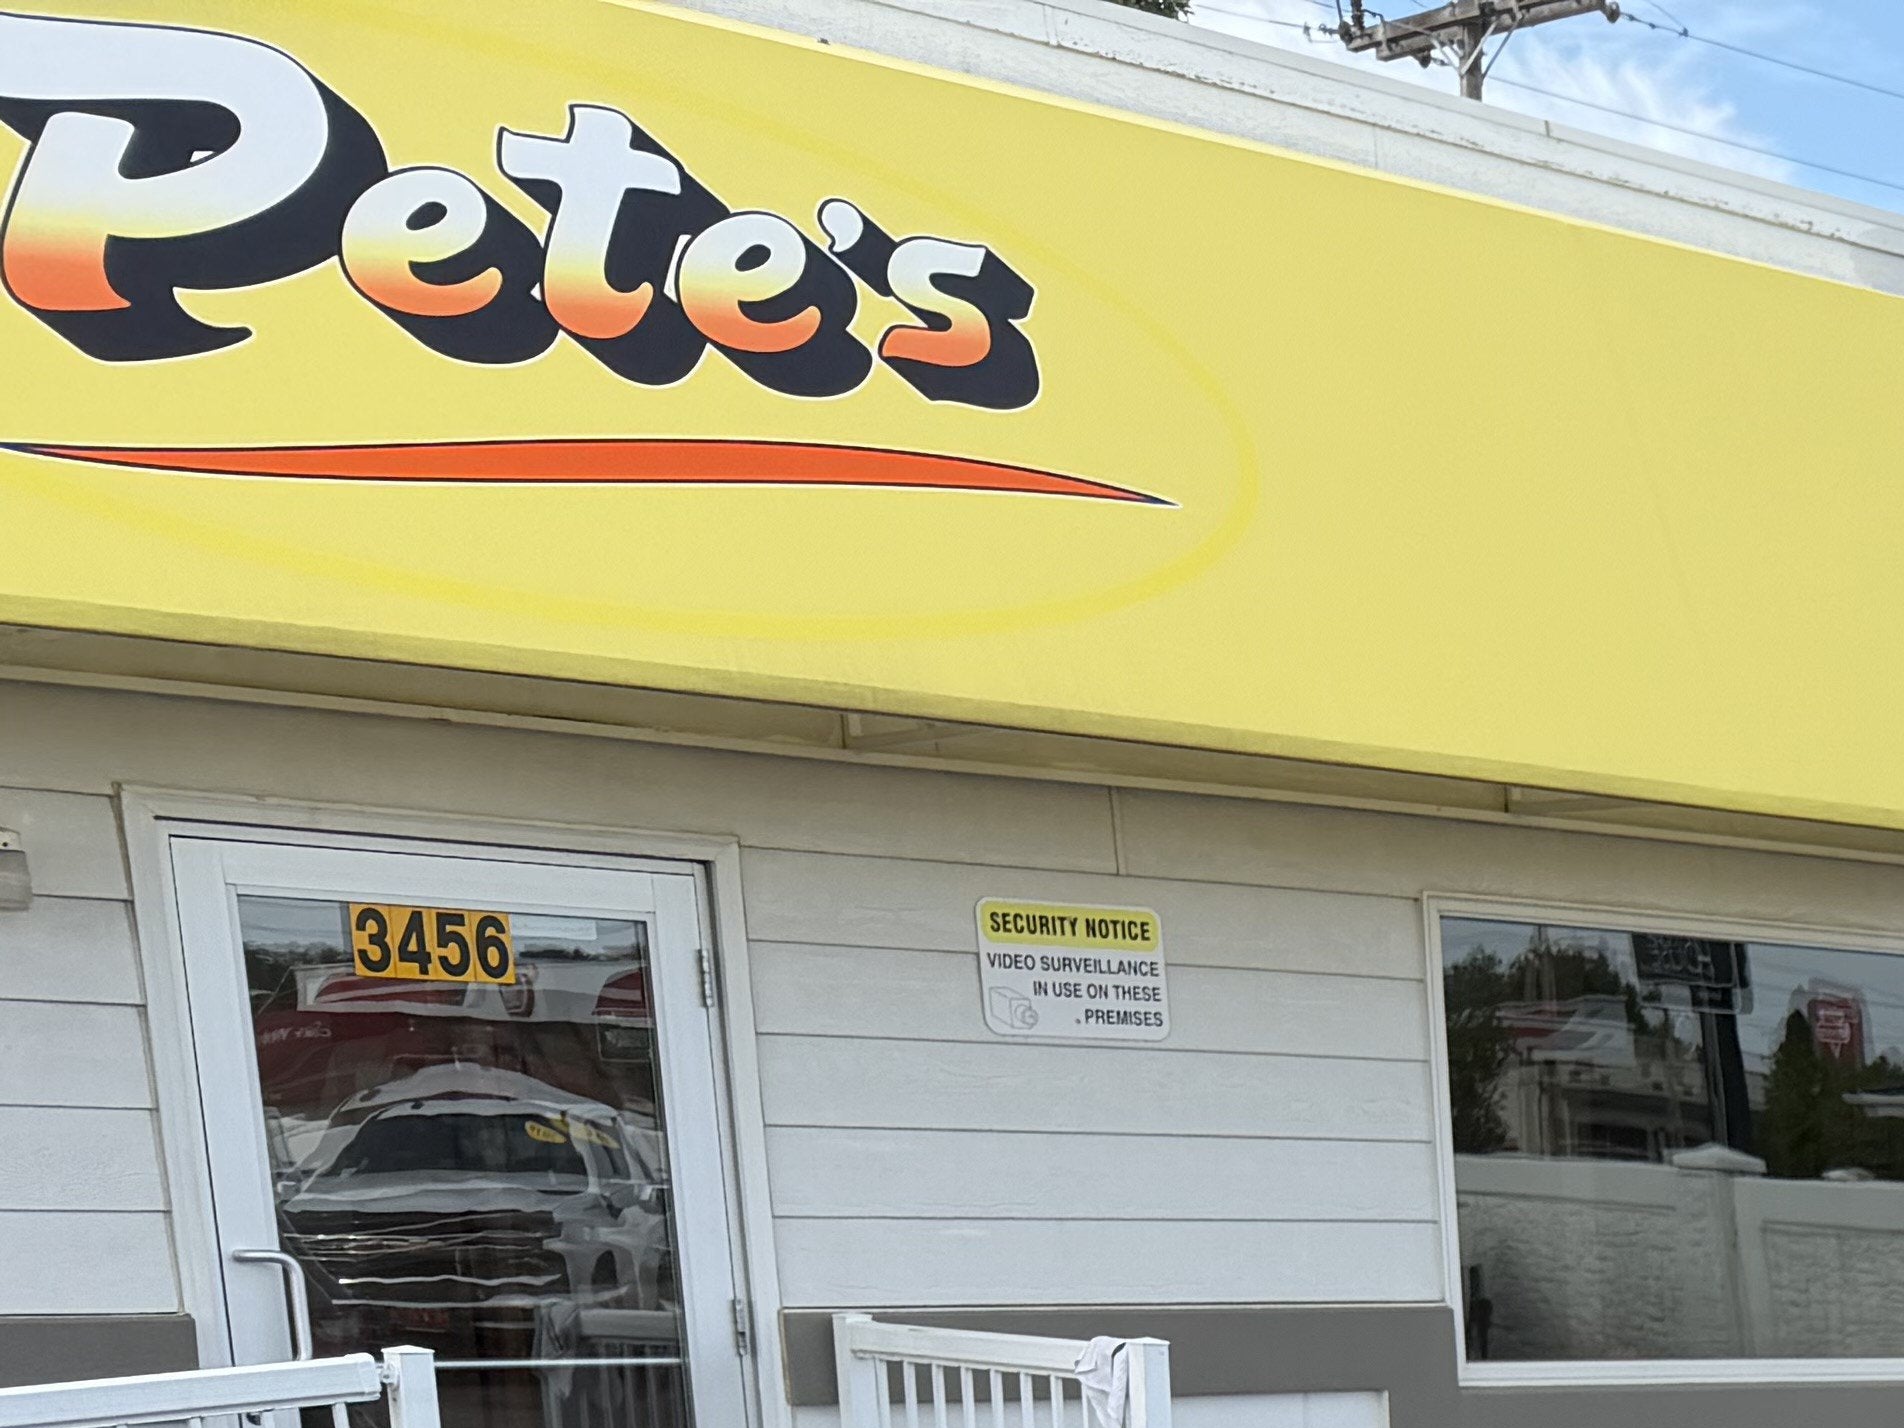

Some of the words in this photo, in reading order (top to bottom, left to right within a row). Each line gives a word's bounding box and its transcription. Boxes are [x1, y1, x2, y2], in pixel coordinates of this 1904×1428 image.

[0, 14, 1040, 410] Pete's
[989, 911, 1078, 937] SECURITY
[1085, 917, 1151, 941] NOTICE
[355, 907, 510, 980] 3456
[986, 952, 1036, 971] VIDEO
[1040, 955, 1160, 977] SURVEILLANCE
[1033, 980, 1048, 996] IN
[1052, 982, 1083, 999] USE
[1087, 983, 1109, 1000] ON
[1112, 984, 1162, 1002] THESE
[1084, 1008, 1163, 1027] PREMISES
